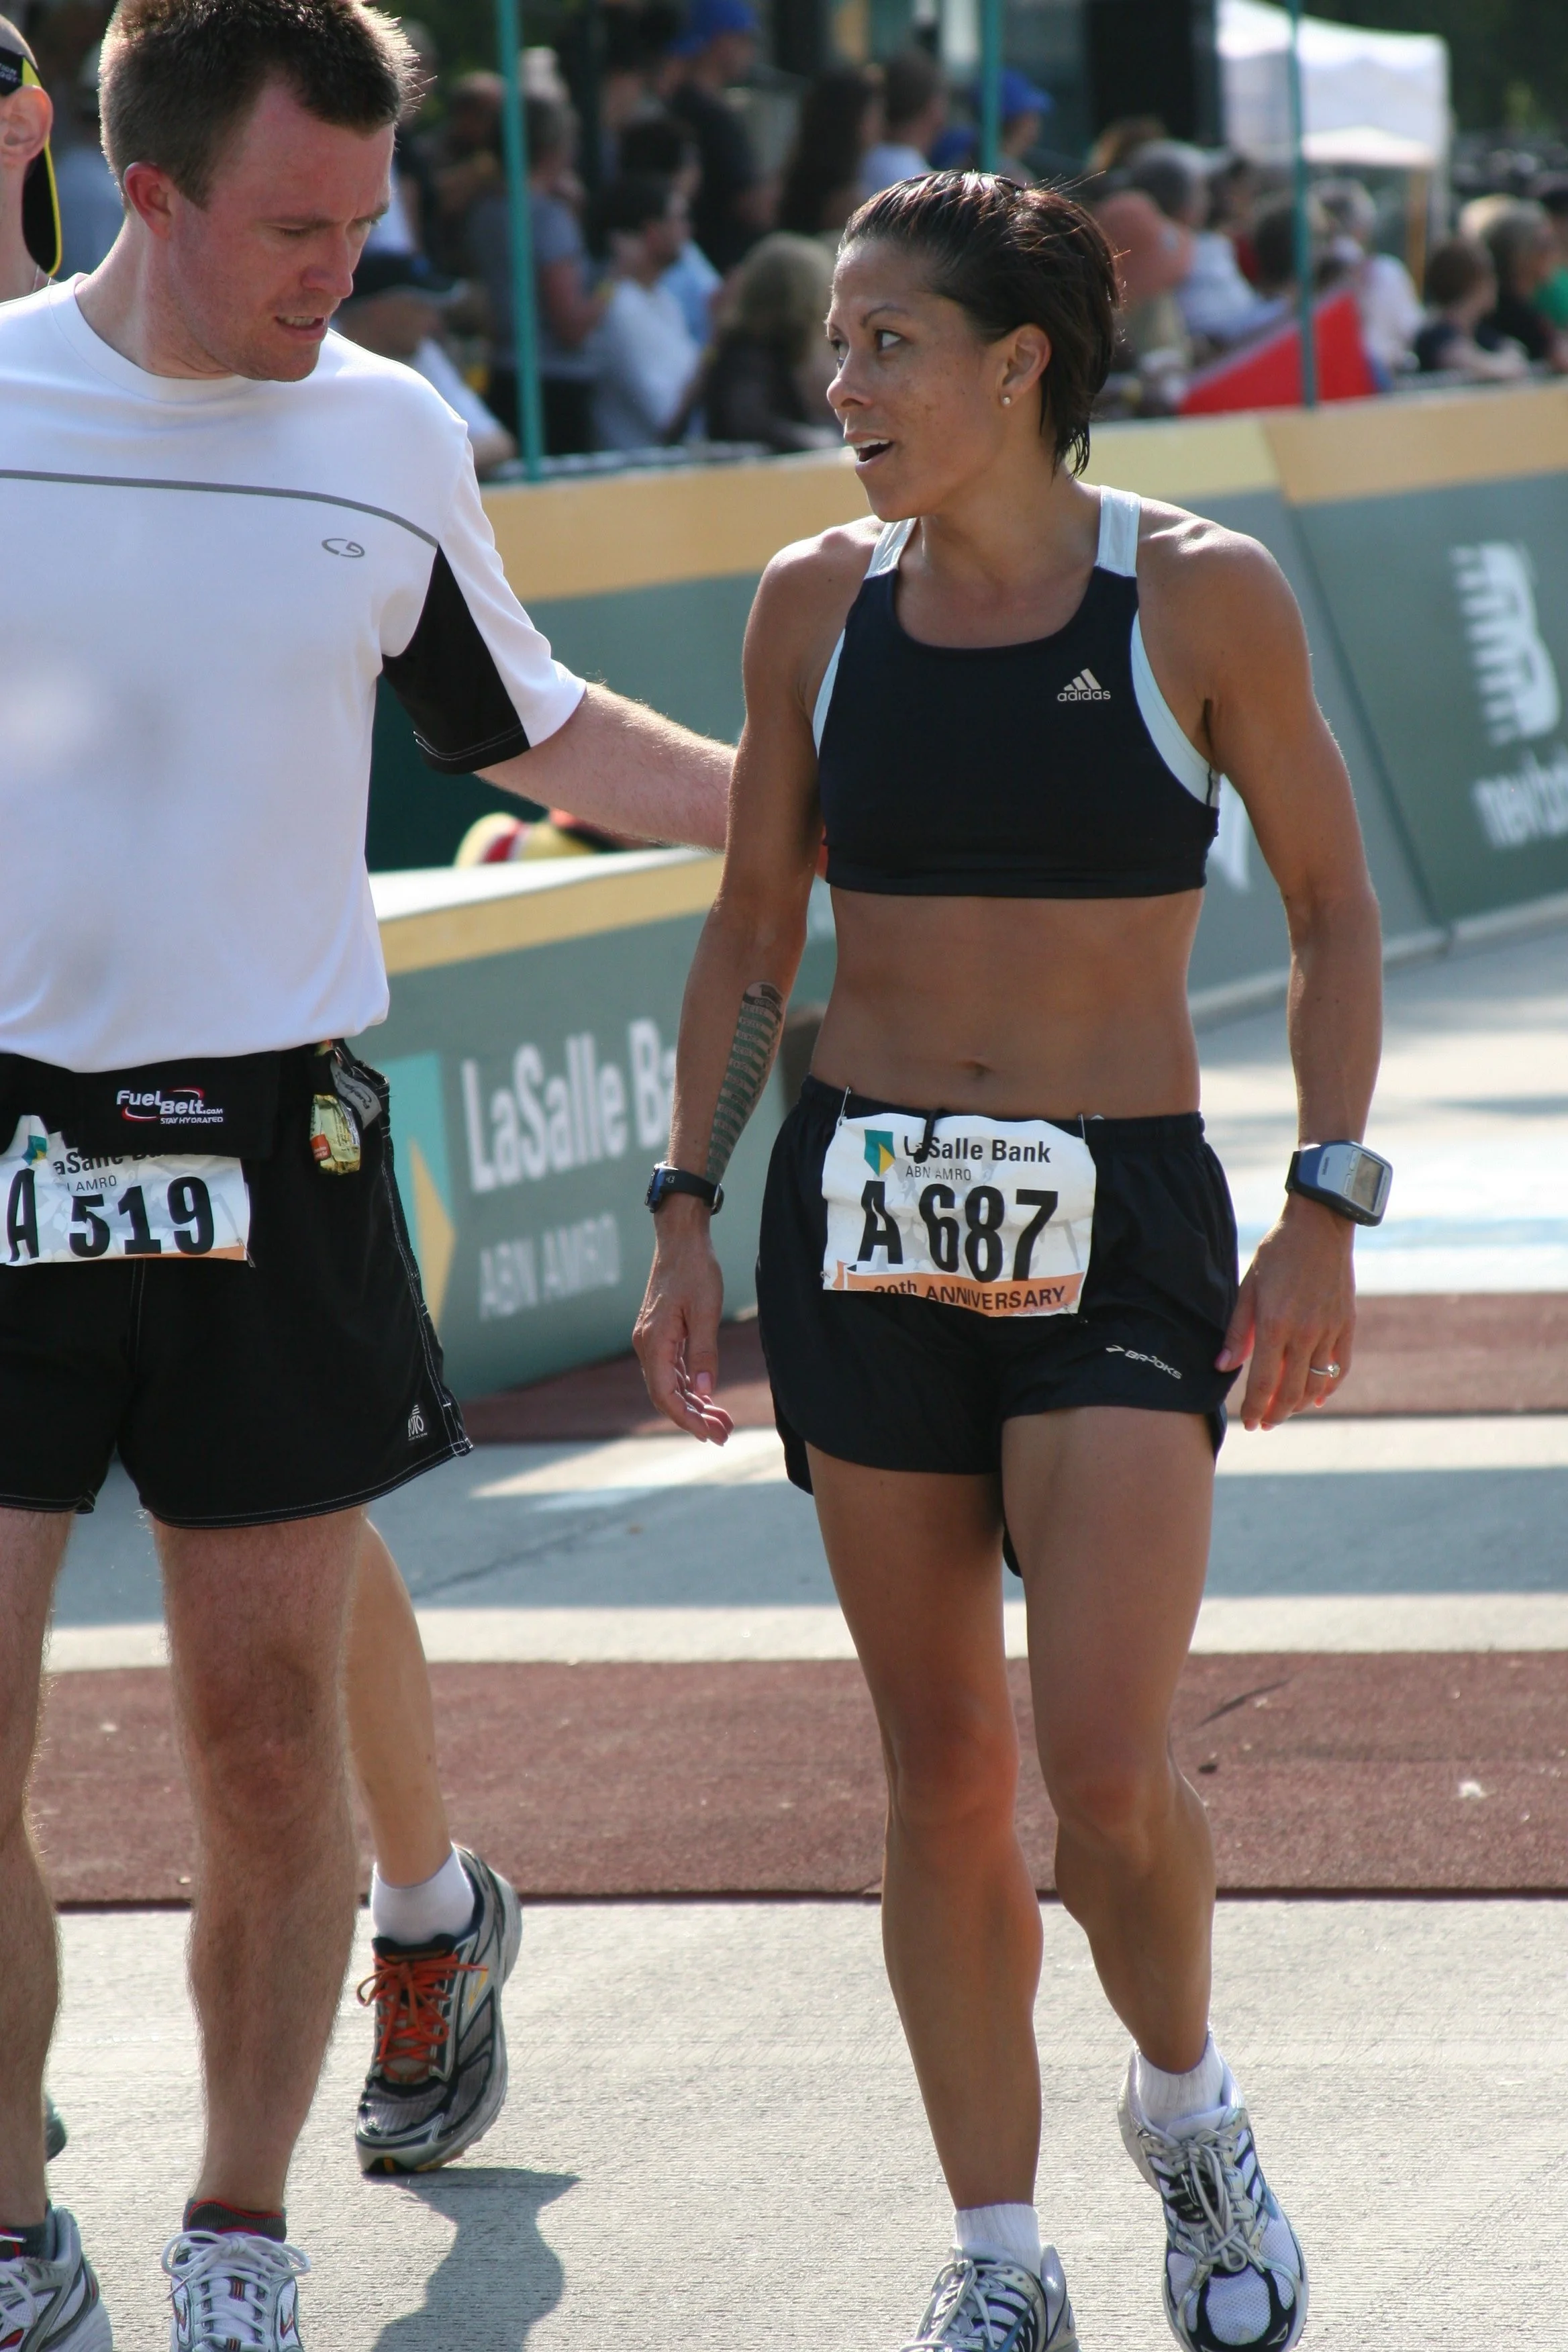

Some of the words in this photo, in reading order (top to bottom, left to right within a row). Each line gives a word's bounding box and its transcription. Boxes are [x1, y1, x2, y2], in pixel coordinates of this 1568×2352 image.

[1057, 688, 1112, 701] adidas
[461, 1031, 628, 1194] LaSalle
[903, 1134, 983, 1161] LSalle
[991, 1139, 1051, 1163] Bank
[76, 1175, 117, 1192] AMRO
[905, 1165, 930, 1179] ABN
[935, 1167, 971, 1181] AMRO
[7, 1168, 40, 1263] A
[68, 1175, 215, 1259] 519
[856, 1179, 903, 1265] A
[918, 1183, 1059, 1283] 687
[926, 1285, 1066, 1310] ANNIVERSARY
[1125, 1350, 1182, 1380] BROOKS
